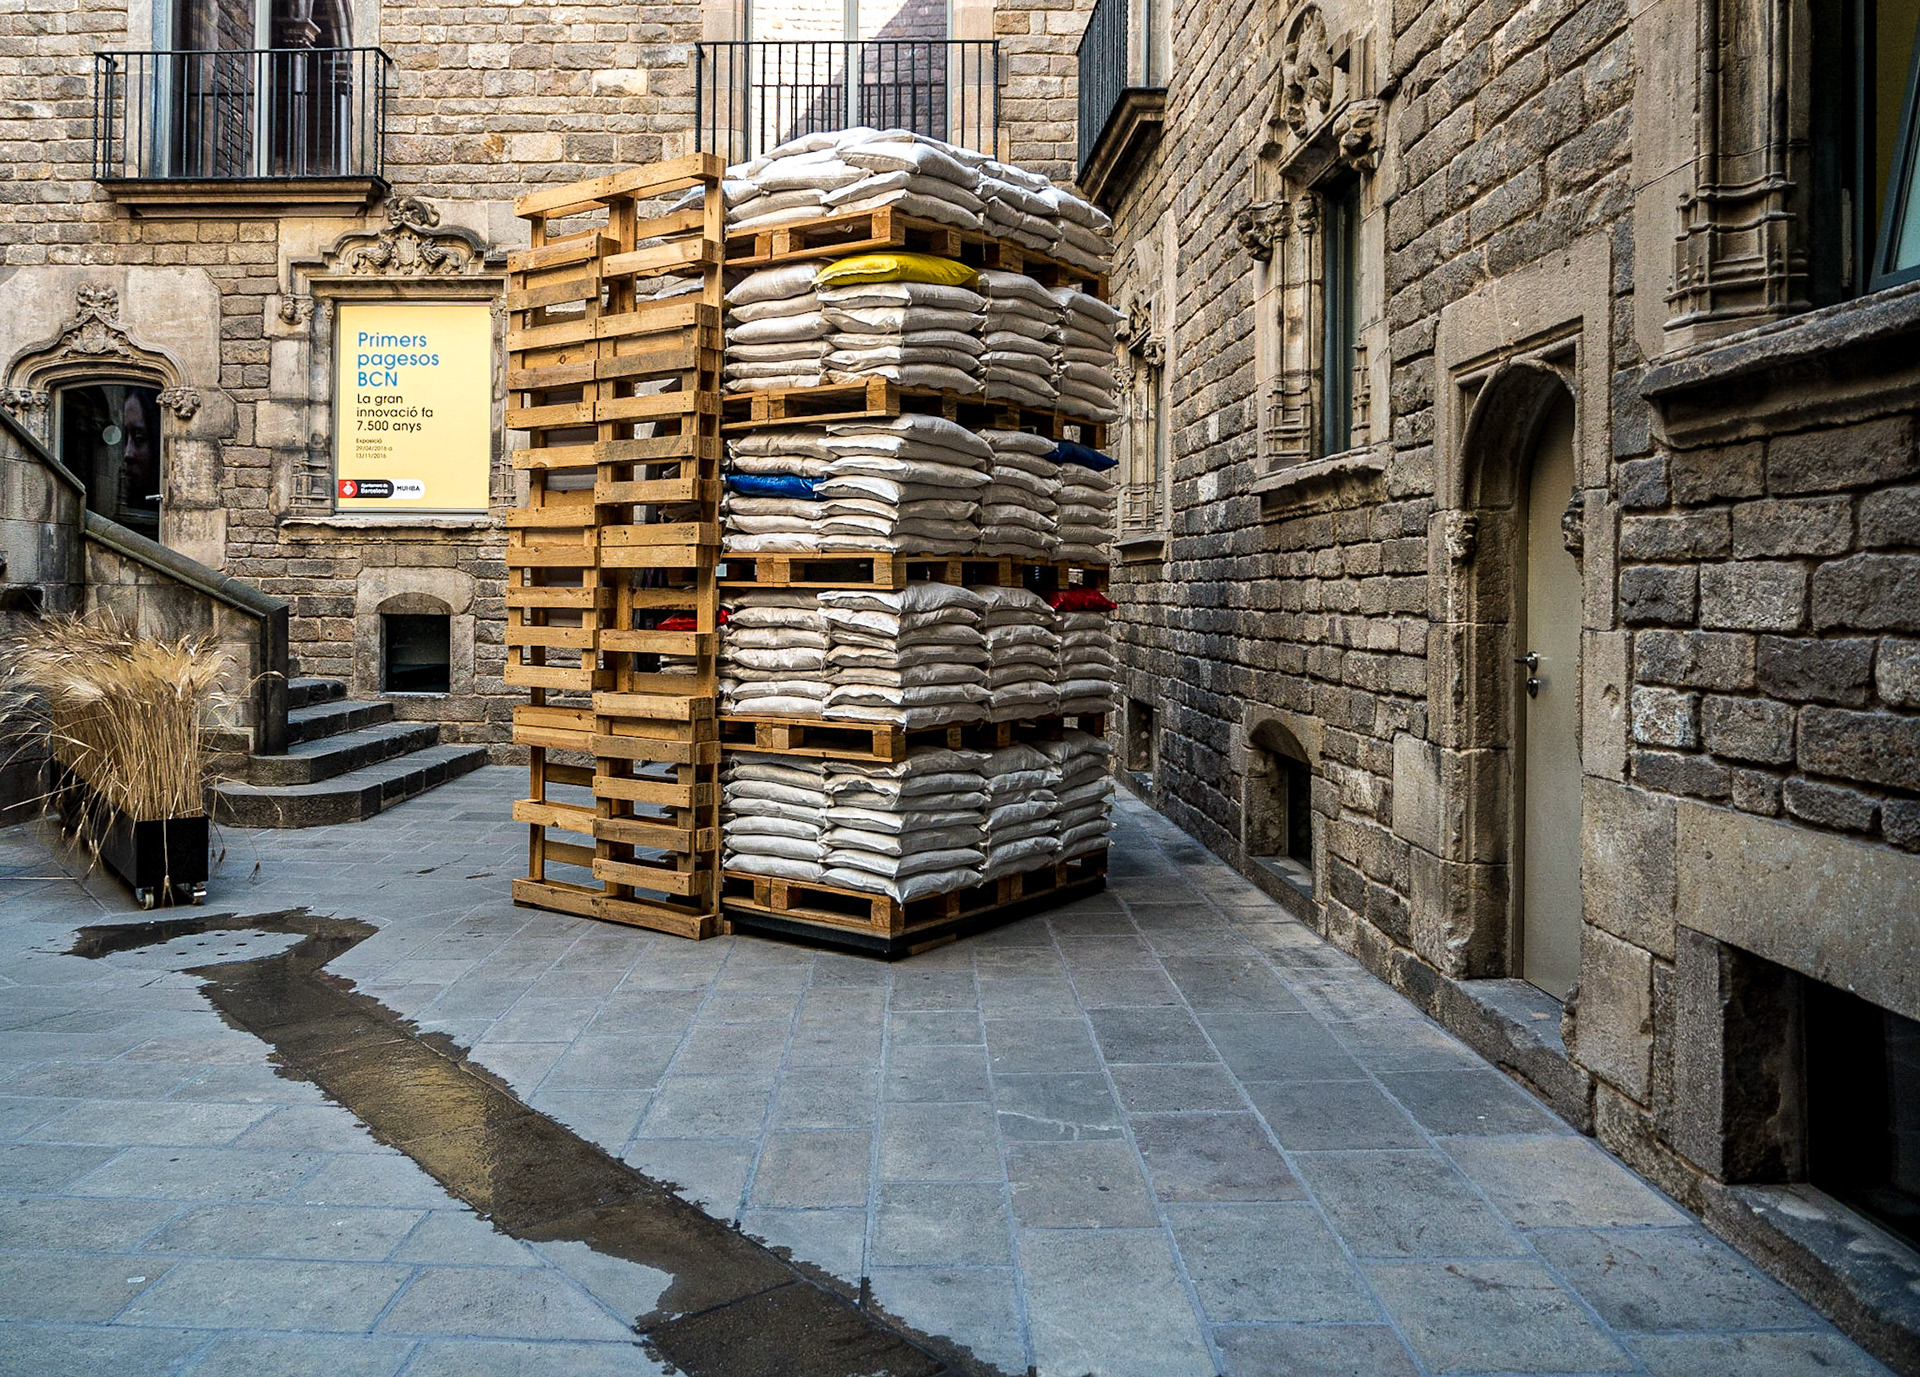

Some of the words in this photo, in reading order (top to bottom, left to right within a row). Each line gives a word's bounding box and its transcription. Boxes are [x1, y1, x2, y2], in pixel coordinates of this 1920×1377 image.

[358, 332, 427, 347] Primers
[357, 353, 440, 370] pagesos
[357, 371, 398, 387] BCN
[357, 393, 371, 404] La
[374, 395, 404, 406] gran
[356, 406, 418, 418] innovació
[421, 407, 433, 418] fa
[357, 420, 389, 431] 7.500
[392, 422, 422, 433] anys
